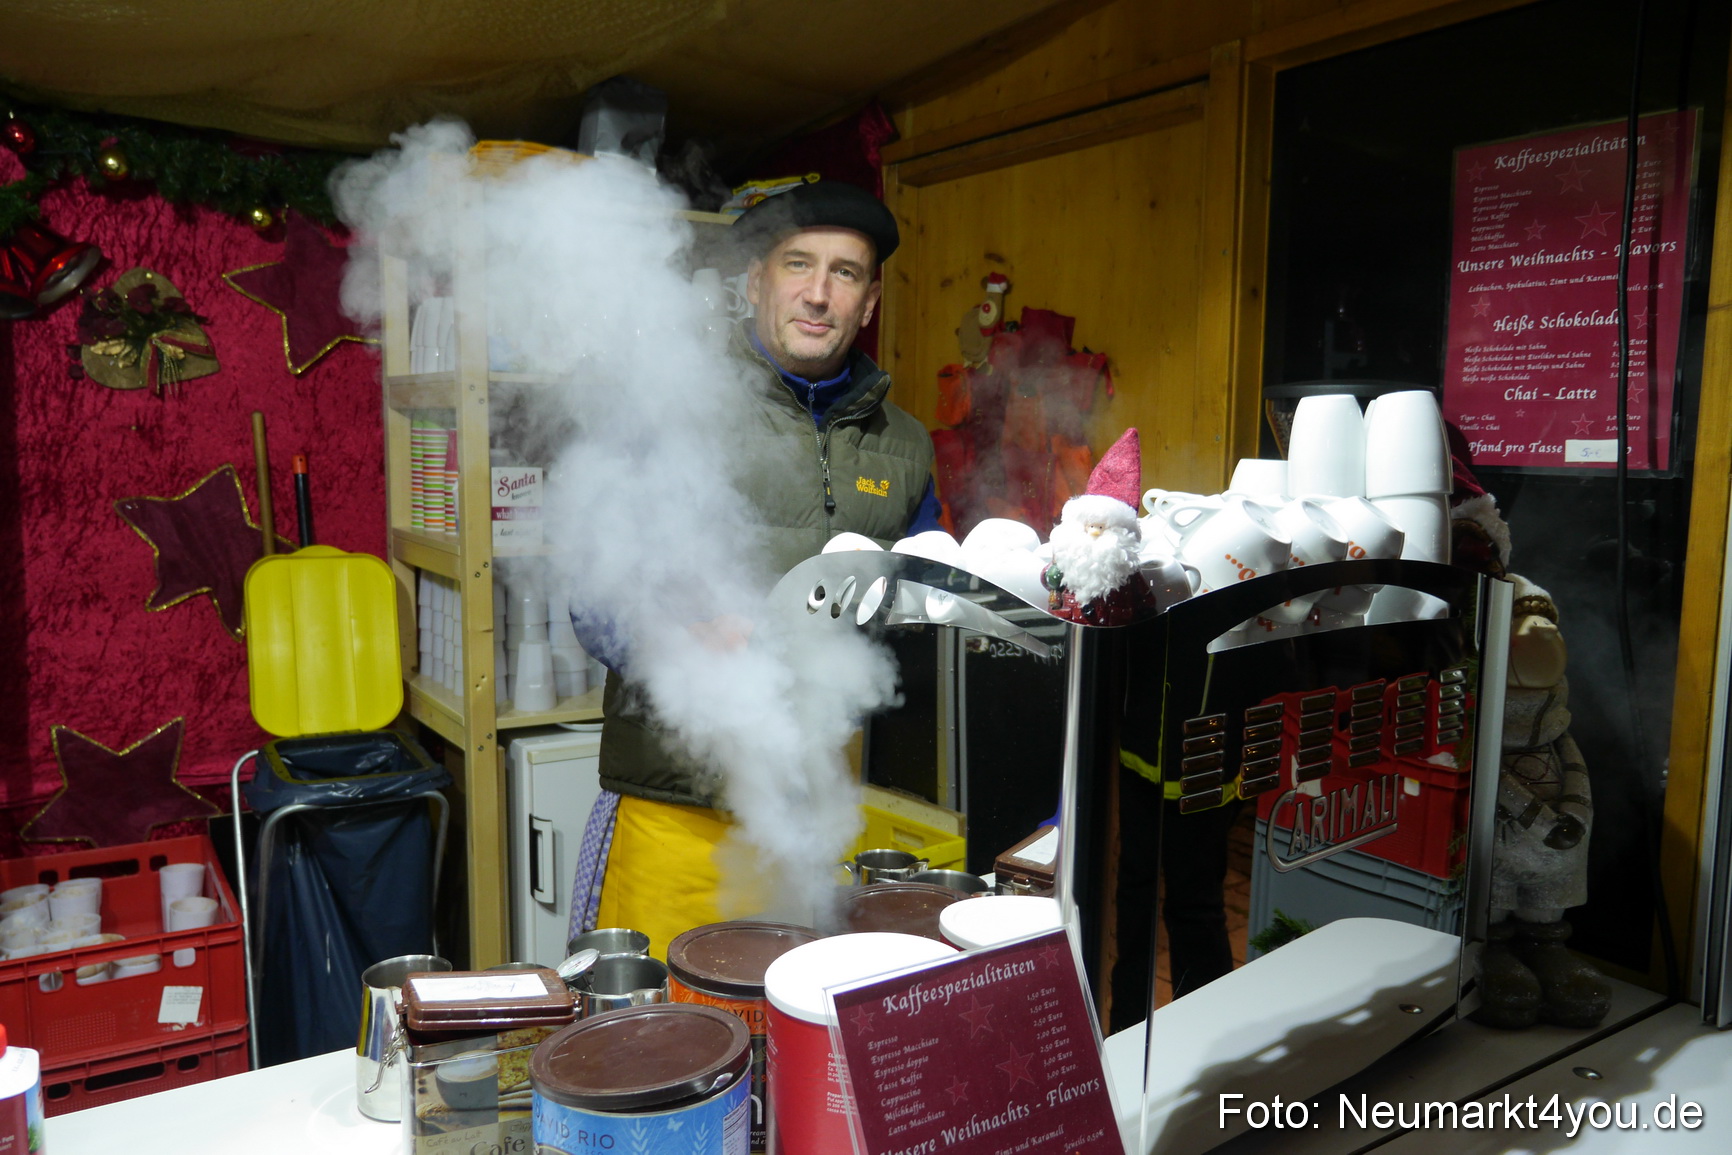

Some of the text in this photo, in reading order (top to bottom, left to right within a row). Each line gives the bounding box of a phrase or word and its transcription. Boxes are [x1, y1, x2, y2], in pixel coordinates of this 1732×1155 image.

[1494, 135, 1647, 173] Kaffeespezialitätn
[1457, 258, 1504, 274] Unsere
[1510, 245, 1594, 268] Weihnachts
[1550, 278, 1567, 286] Zimt
[1569, 275, 1584, 283] und
[1493, 315, 1534, 336] Heiße
[1463, 355, 1480, 364] Heiße
[1482, 354, 1513, 362] Schokolade
[1557, 351, 1569, 359] und
[1464, 345, 1481, 354] Heiße
[1483, 344, 1514, 352] Schokolade
[1462, 365, 1480, 374] Heiße
[1481, 363, 1512, 372] Schokolade
[1551, 361, 1564, 369] und
[1462, 375, 1479, 384] Heiße
[1498, 373, 1530, 381] Schokolade
[1504, 386, 1537, 400] Chai
[1556, 387, 1597, 400] Latte
[1460, 414, 1475, 424] Tiger
[1468, 439, 1563, 457] Pfand pro Tasse
[497, 473, 536, 497] Santa
[856, 476, 875, 487] Jack
[856, 484, 887, 497] Wolfskin
[1266, 774, 1399, 874] CARIMALI
[882, 959, 1035, 1016] Kaffeespezialitäten
[1040, 987, 1056, 996] Euro
[1044, 1000, 1059, 1009] Euro
[1048, 1012, 1063, 1022] Euro
[1051, 1025, 1066, 1035] Euro
[868, 1036, 898, 1051] Espresso
[871, 1038, 939, 1065] Espresso Macchiato
[1054, 1038, 1070, 1048] Euro
[1057, 1051, 1072, 1060] Euro
[874, 1056, 929, 1080] Espresso doppio
[878, 1071, 922, 1092] Tasse Kaffee
[881, 1086, 921, 1108] Cappuccino
[884, 1101, 925, 1121] Milchkaffee
[941, 1101, 1030, 1146] Weihnachts
[1046, 1078, 1100, 1108] Flavors
[536, 1102, 615, 1149] DAVID RIO
[888, 1110, 945, 1136] Latte Macchiato
[1015, 1139, 1029, 1154] und
[1031, 1124, 1064, 1146] Karamell
[1064, 1135, 1085, 1152] Jeweils
